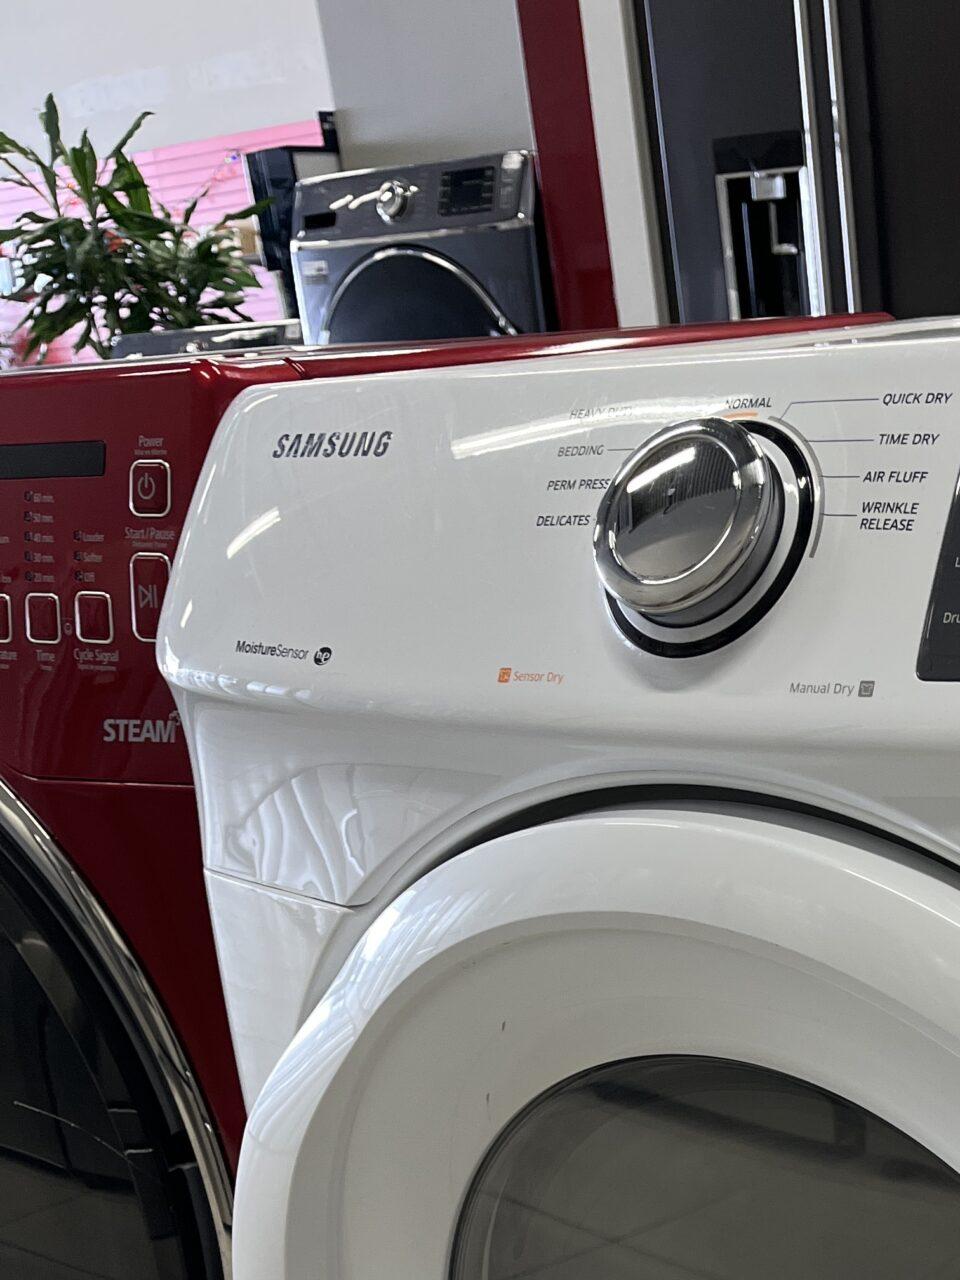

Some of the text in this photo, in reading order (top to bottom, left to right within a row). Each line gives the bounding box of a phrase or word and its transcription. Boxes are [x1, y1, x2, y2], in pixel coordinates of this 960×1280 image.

[725, 397, 773, 410] NORMAL
[883, 392, 953, 406] QUICK DRY
[138, 435, 164, 448] Power
[272, 431, 393, 458] SAMSUNG
[879, 433, 940, 446] TIME DRY
[557, 444, 605, 457] BEDDING
[863, 471, 929, 483] AIR FLUFF
[547, 478, 611, 491] PERM PRESS
[862, 502, 919, 515] WRINKLE
[536, 514, 591, 527] DELICATES
[859, 518, 915, 532] RELEASE
[235, 640, 309, 661] MoistureSensor
[513, 670, 565, 685] Sensor Dry
[789, 682, 855, 697] Manual Dry
[103, 718, 176, 744] STEAM
